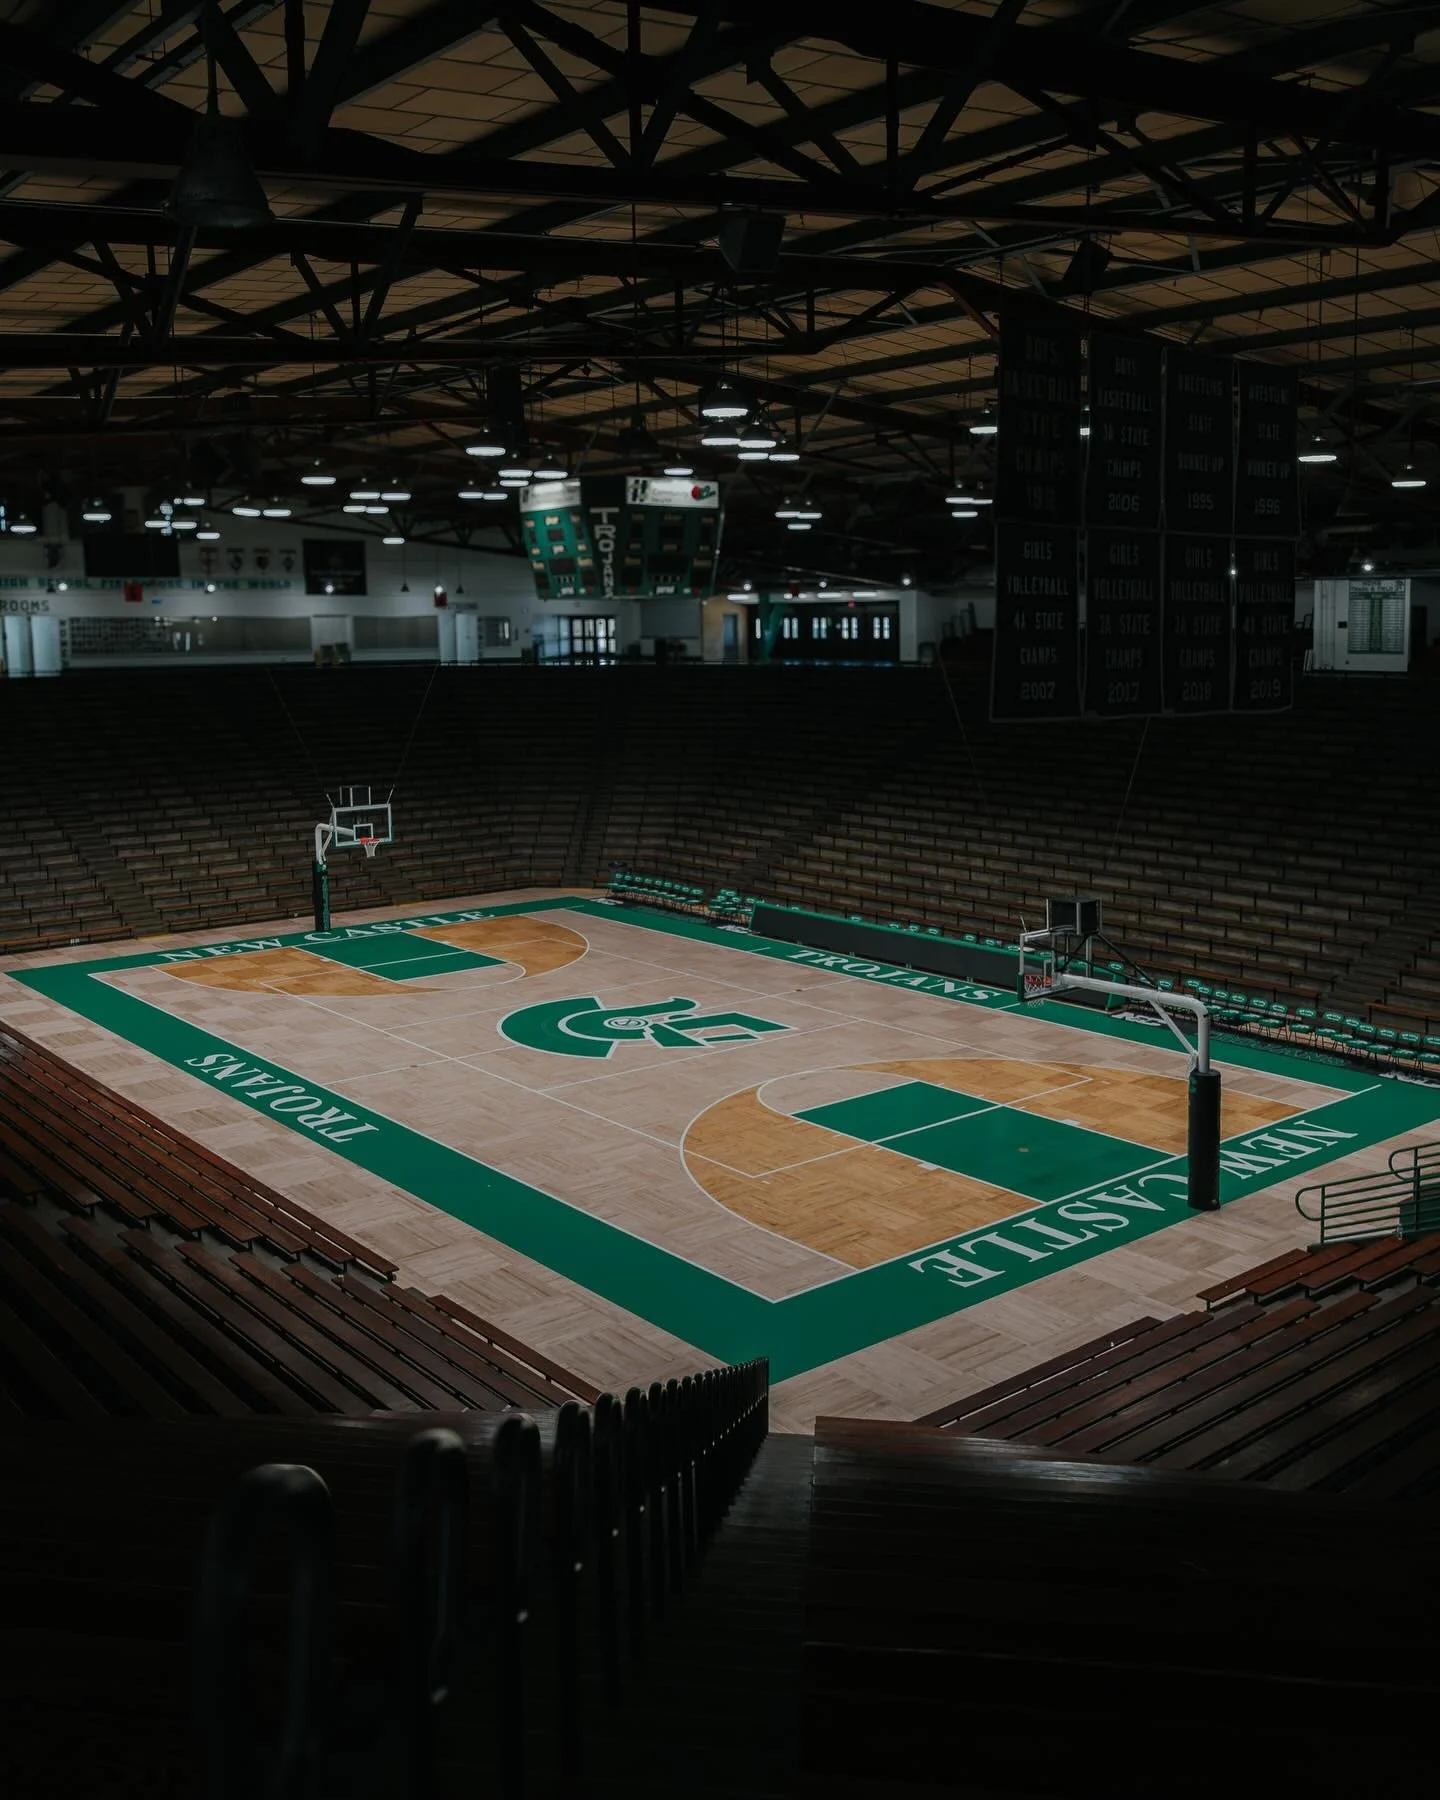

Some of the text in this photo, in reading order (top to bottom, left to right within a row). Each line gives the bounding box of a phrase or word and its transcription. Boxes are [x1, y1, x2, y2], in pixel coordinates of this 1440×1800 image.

[1108, 492, 1142, 513] 2006
[1187, 492, 1215, 511] 1995
[1254, 497, 1282, 515] 1996
[1022, 541, 1053, 560] GIRLS
[1109, 543, 1140, 566] GIRLS
[1184, 547, 1212, 569] GIRLS
[1007, 575, 1069, 596] VOLLEYBALL
[1093, 578, 1154, 602] VOLLEYBALL
[1170, 580, 1225, 603] VOLLEYBALL
[1013, 610, 1065, 631] 4A STATE
[1118, 613, 1152, 635] STATE
[1193, 615, 1222, 636] STATE
[1262, 616, 1290, 635] STATE
[1020, 647, 1058, 665] CHAMPS
[1105, 648, 1143, 669] CHAMPS
[1179, 648, 1216, 669] CHAMPS
[1248, 648, 1283, 667] CHAMPS
[1020, 681, 1056, 700] 2007
[1108, 681, 1141, 703] 2017
[1250, 678, 1282, 699] 2019
[161, 910, 495, 962] NEW CASTLE
[786, 948, 1003, 1001] TROJANS
[184, 1053, 380, 1144] TROJANS
[908, 1120, 1360, 1288] NEW CASTLE
